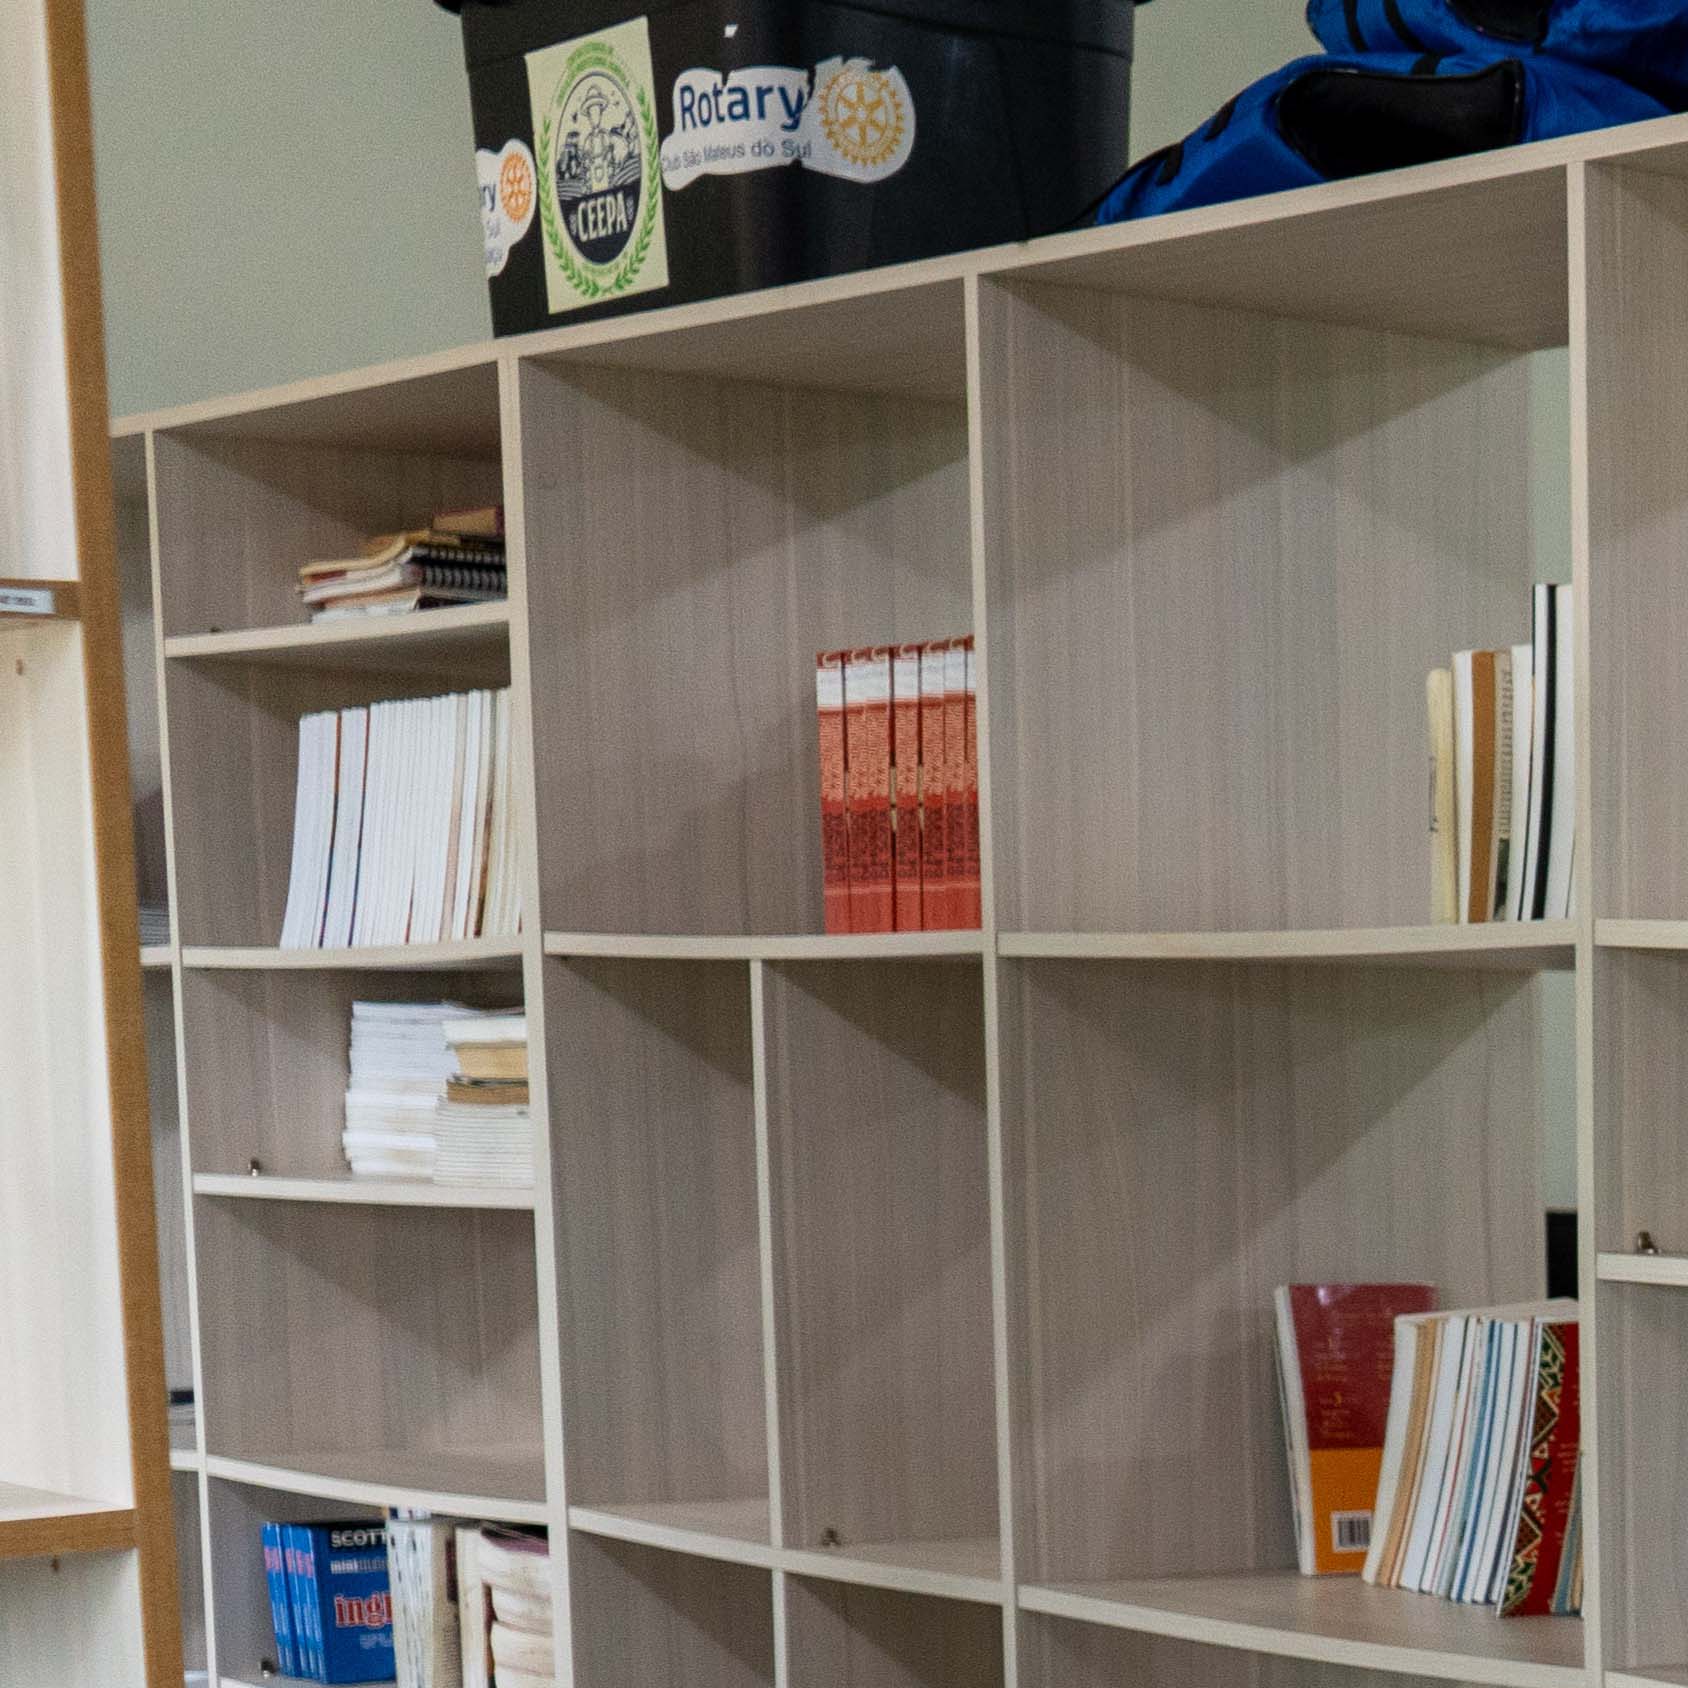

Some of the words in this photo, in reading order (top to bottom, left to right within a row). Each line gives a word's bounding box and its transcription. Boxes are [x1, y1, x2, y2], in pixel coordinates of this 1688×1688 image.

[680, 82, 804, 132] Rotary
[751, 137, 775, 158] do
[781, 137, 812, 159] Sul
[577, 190, 627, 242] CEEPA
